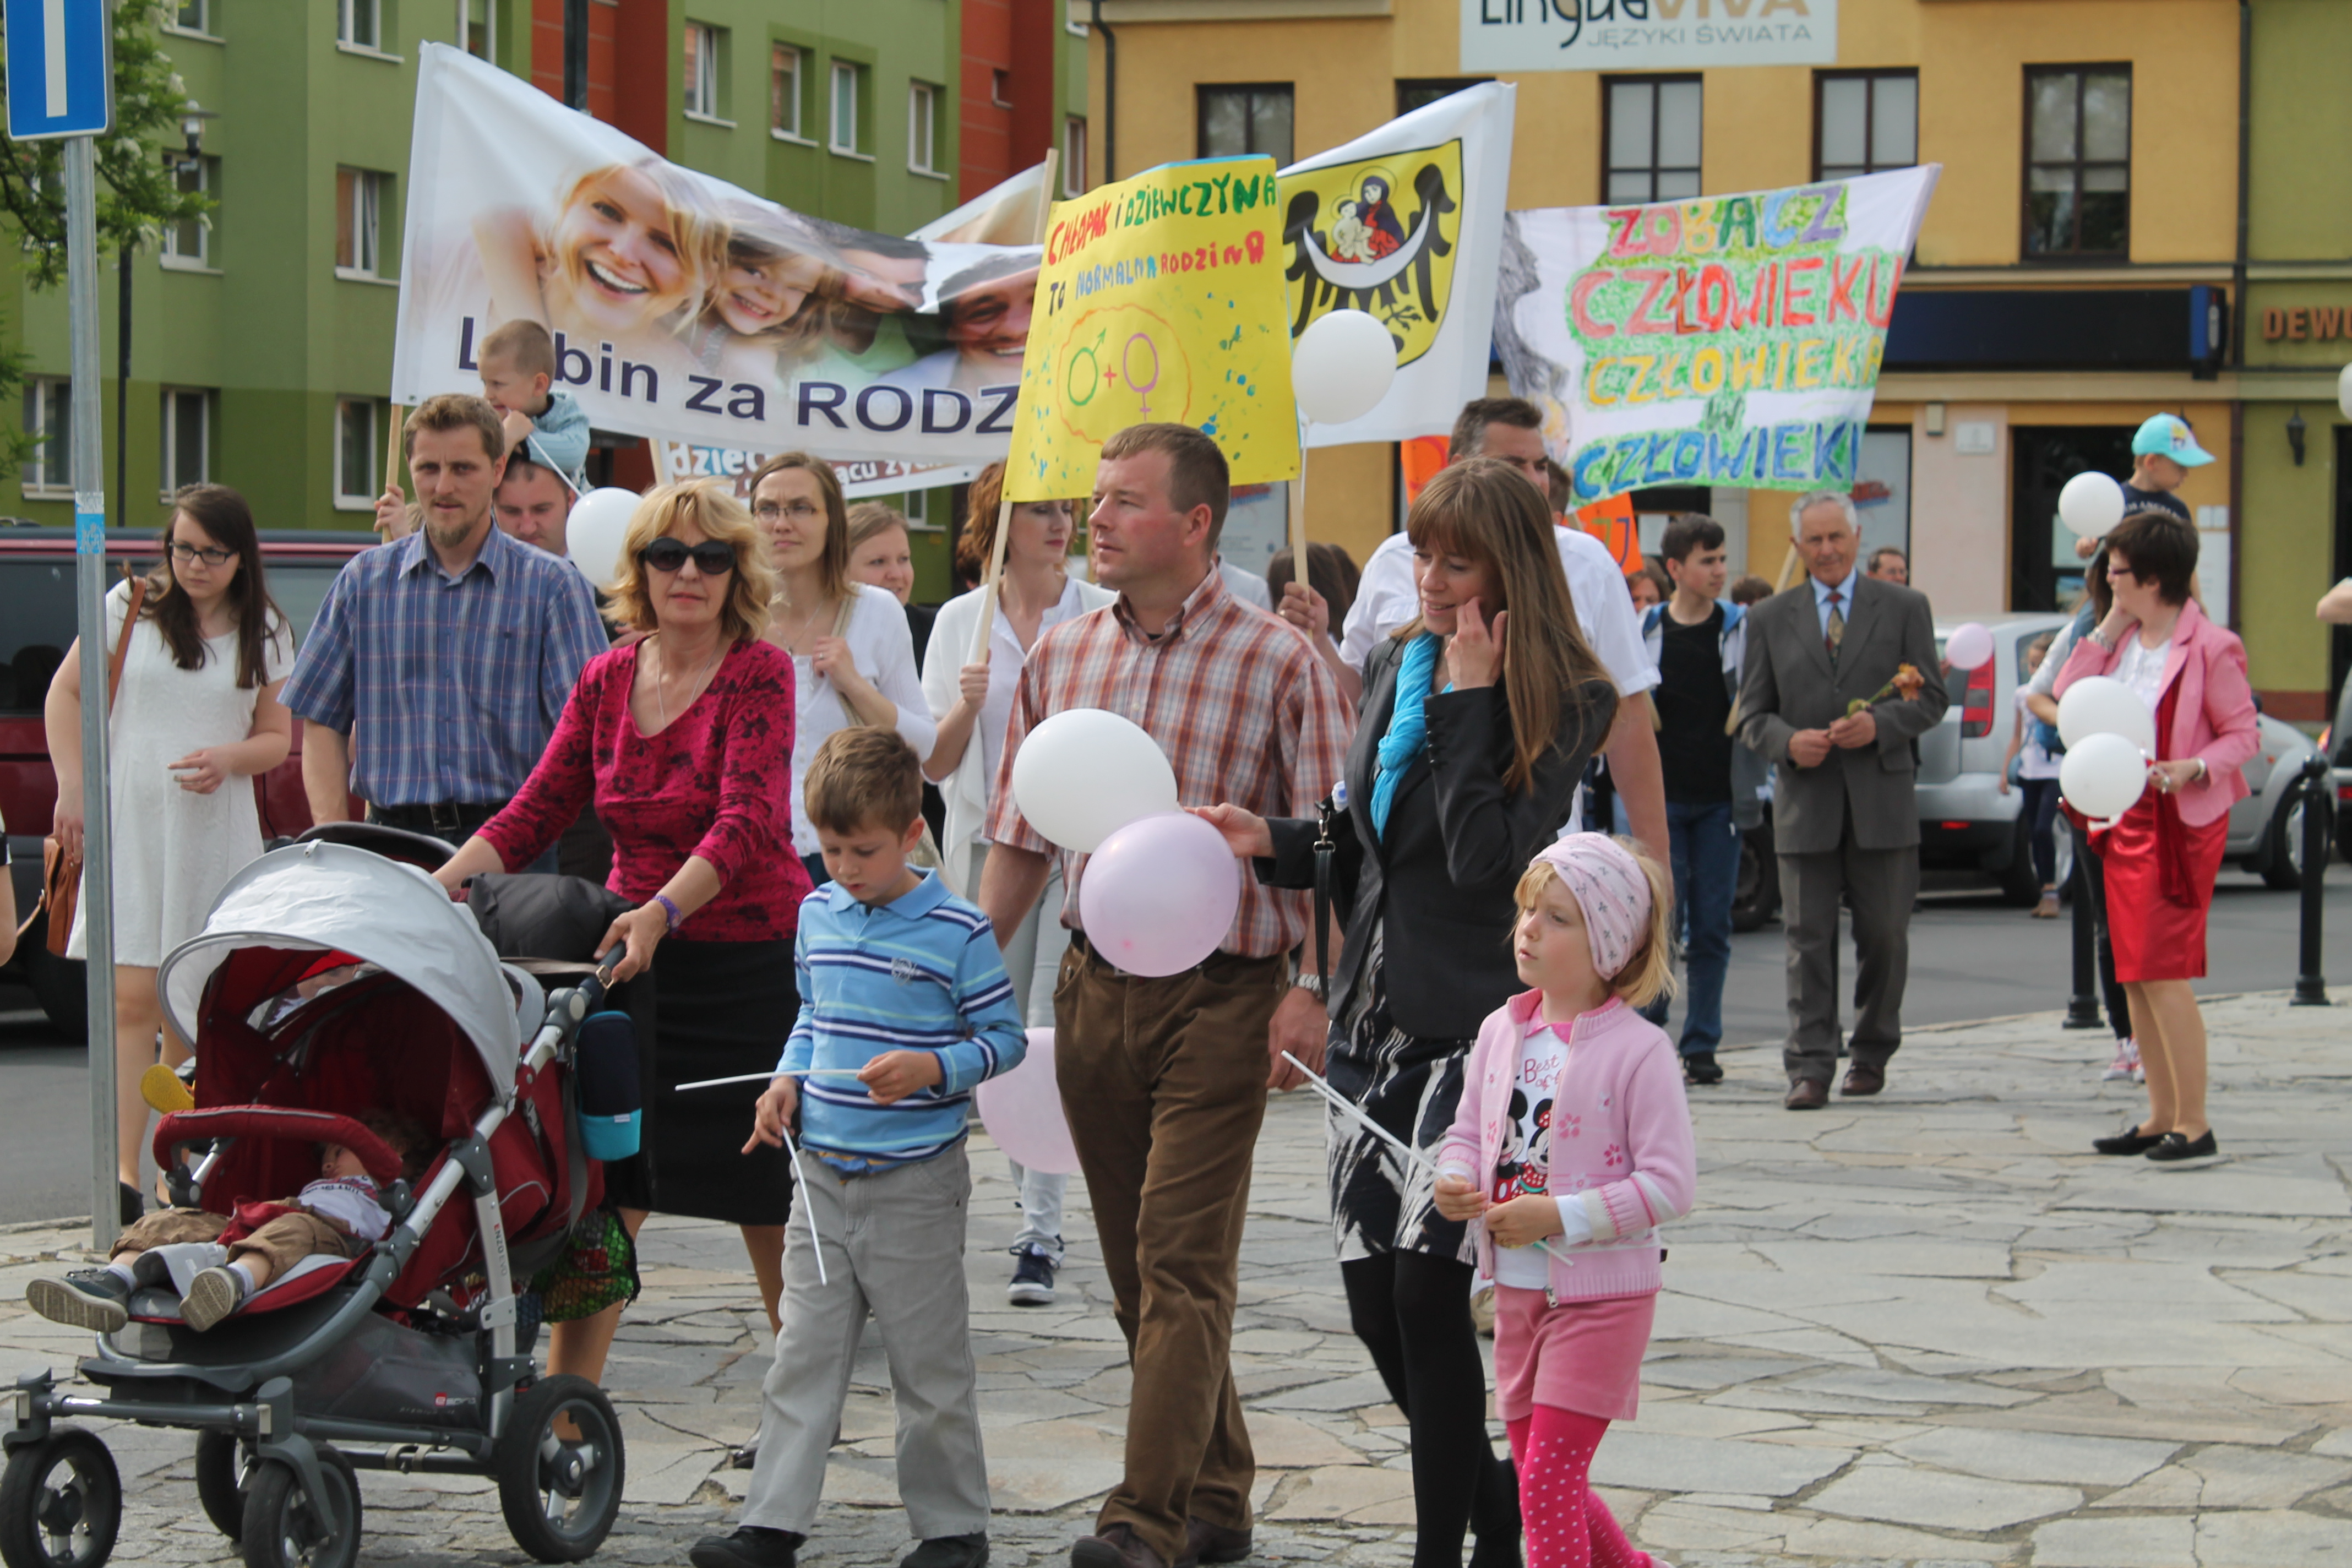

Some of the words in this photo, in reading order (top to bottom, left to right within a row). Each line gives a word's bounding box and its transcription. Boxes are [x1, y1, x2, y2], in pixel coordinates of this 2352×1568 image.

[1587, 28, 1685, 48] JĘZYKI
[1695, 24, 1812, 45] ŚWIATA
[1607, 184, 1843, 257] ZOBACZ
[1049, 281, 1066, 317] TO
[1075, 255, 1157, 301] NORMALNA
[458, 315, 659, 403] Lbin
[685, 373, 766, 421] za
[669, 442, 760, 477] dziec
[1525, 1054, 1560, 1084] Best
